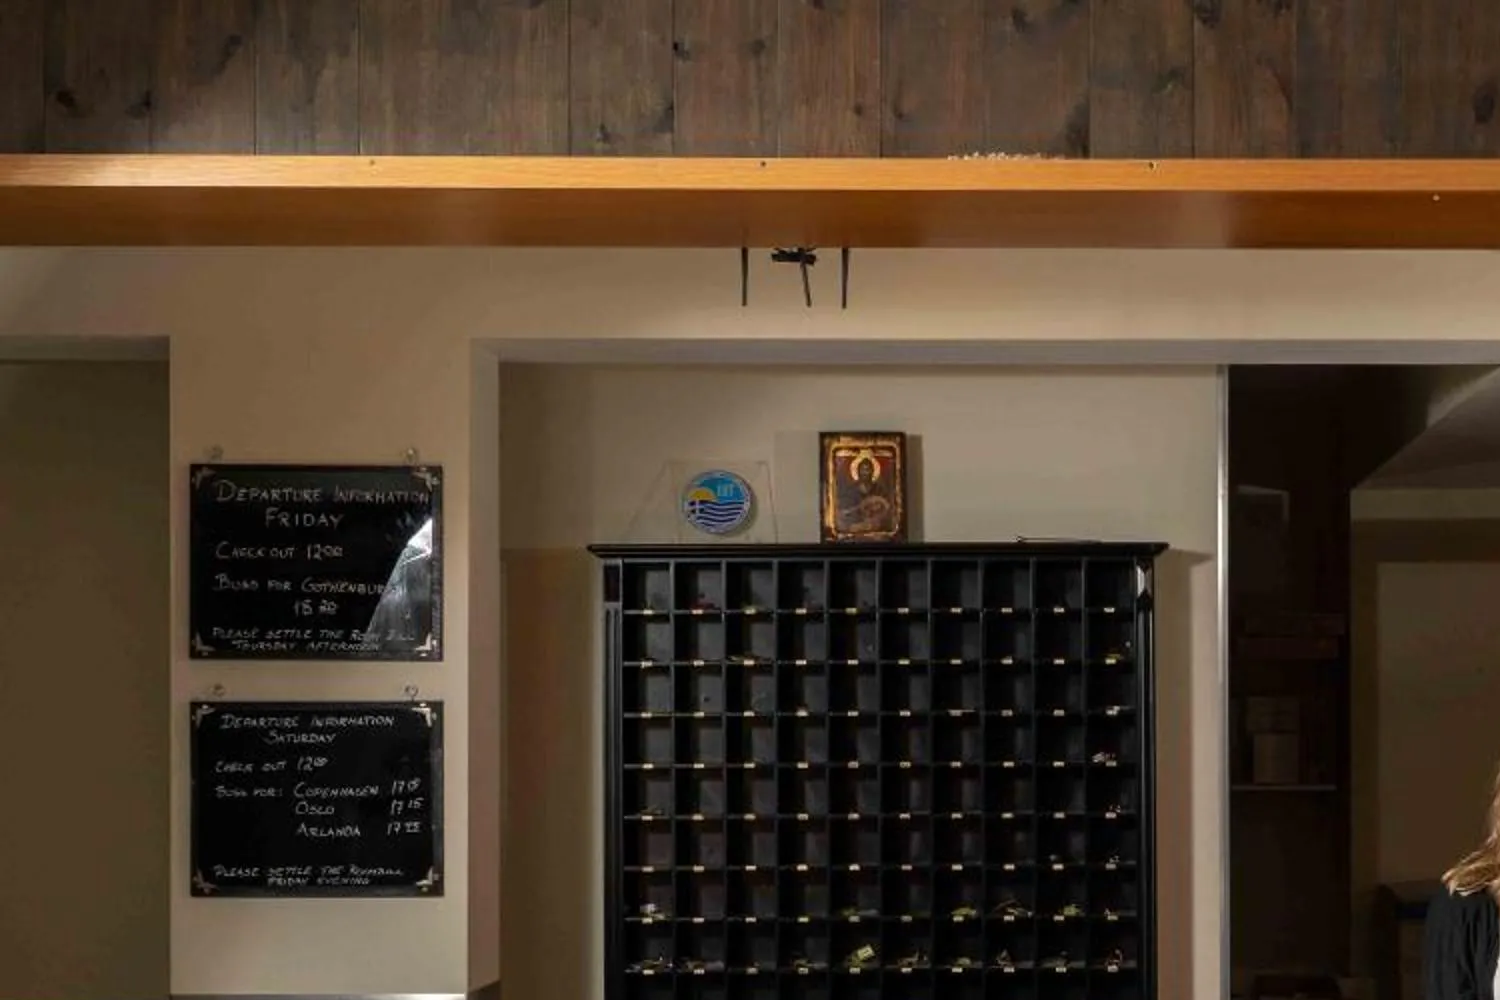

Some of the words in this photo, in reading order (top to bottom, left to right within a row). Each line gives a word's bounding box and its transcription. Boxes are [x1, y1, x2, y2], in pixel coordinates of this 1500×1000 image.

[216, 480, 321, 502] DEPARTURE
[265, 507, 343, 528] FRIDAY
[301, 576, 396, 596] GOTHENBUR
[262, 729, 337, 745] SATURDAY
